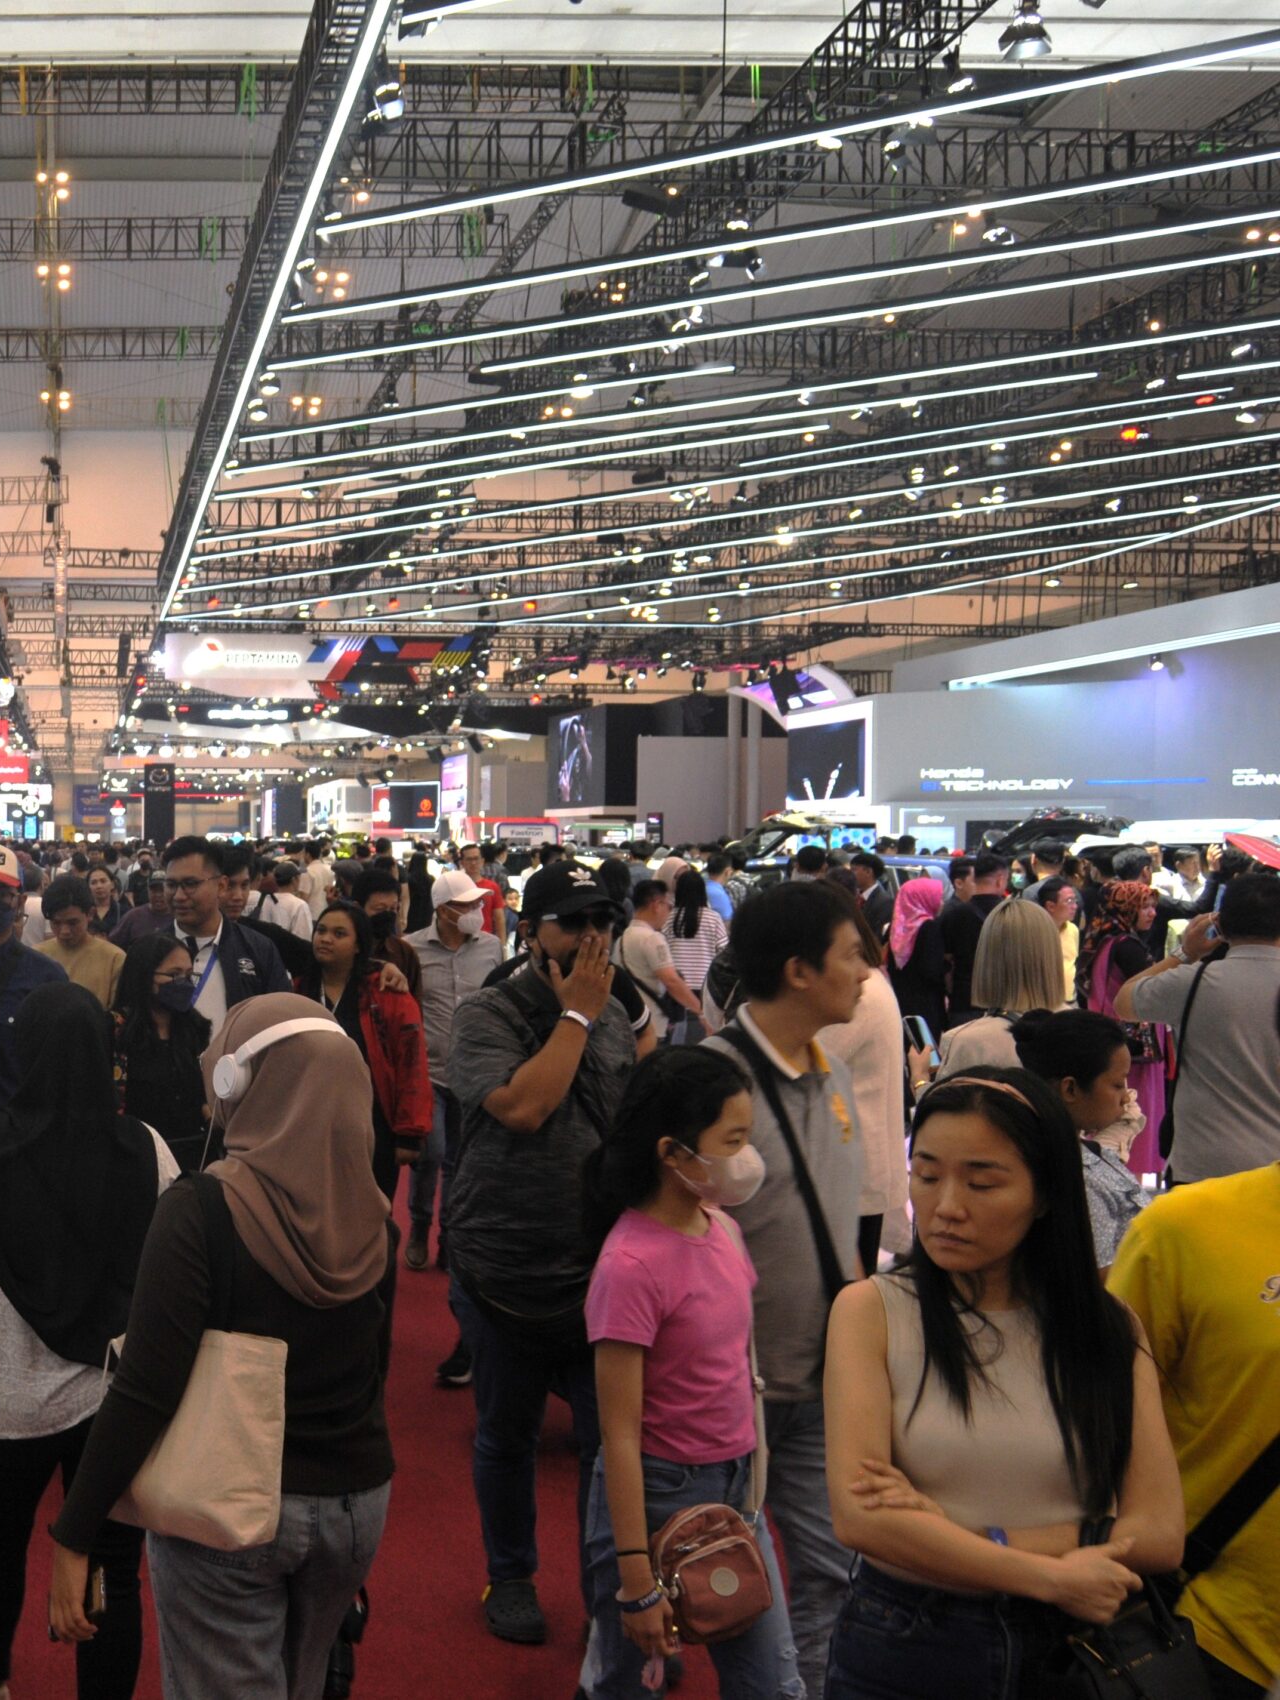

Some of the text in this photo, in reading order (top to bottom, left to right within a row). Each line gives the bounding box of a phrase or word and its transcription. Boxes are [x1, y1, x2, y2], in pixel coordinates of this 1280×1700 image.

[225, 653, 300, 665] PERTAMINA
[133, 745, 252, 759] VOLVO
[920, 767, 985, 779] Honda
[510, 829, 544, 837] Fastron
